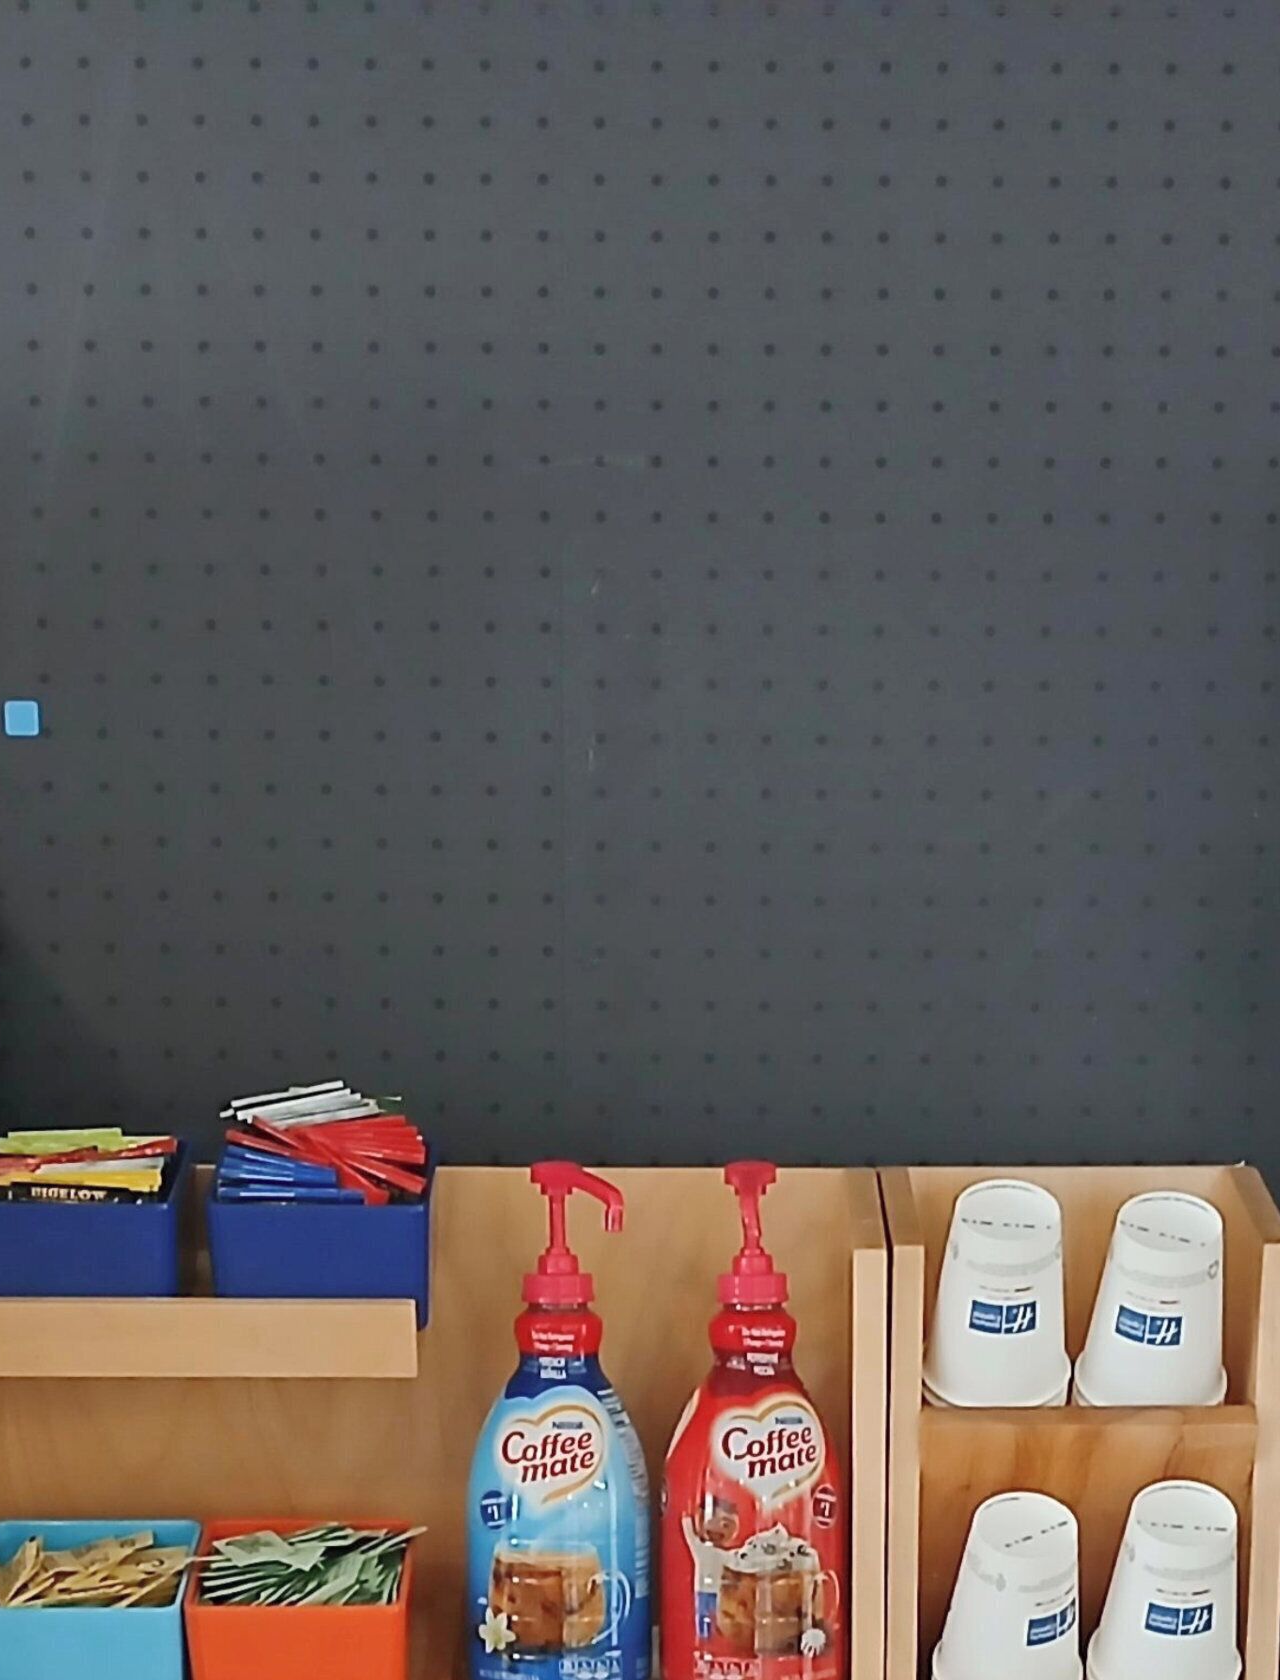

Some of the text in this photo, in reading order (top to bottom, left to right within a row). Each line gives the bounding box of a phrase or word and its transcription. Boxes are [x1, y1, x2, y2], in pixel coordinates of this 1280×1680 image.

[501, 1431, 592, 1464] Coffee
[722, 1427, 812, 1460] Coffee
[521, 1451, 595, 1483] mate
[748, 1445, 817, 1478] mate
